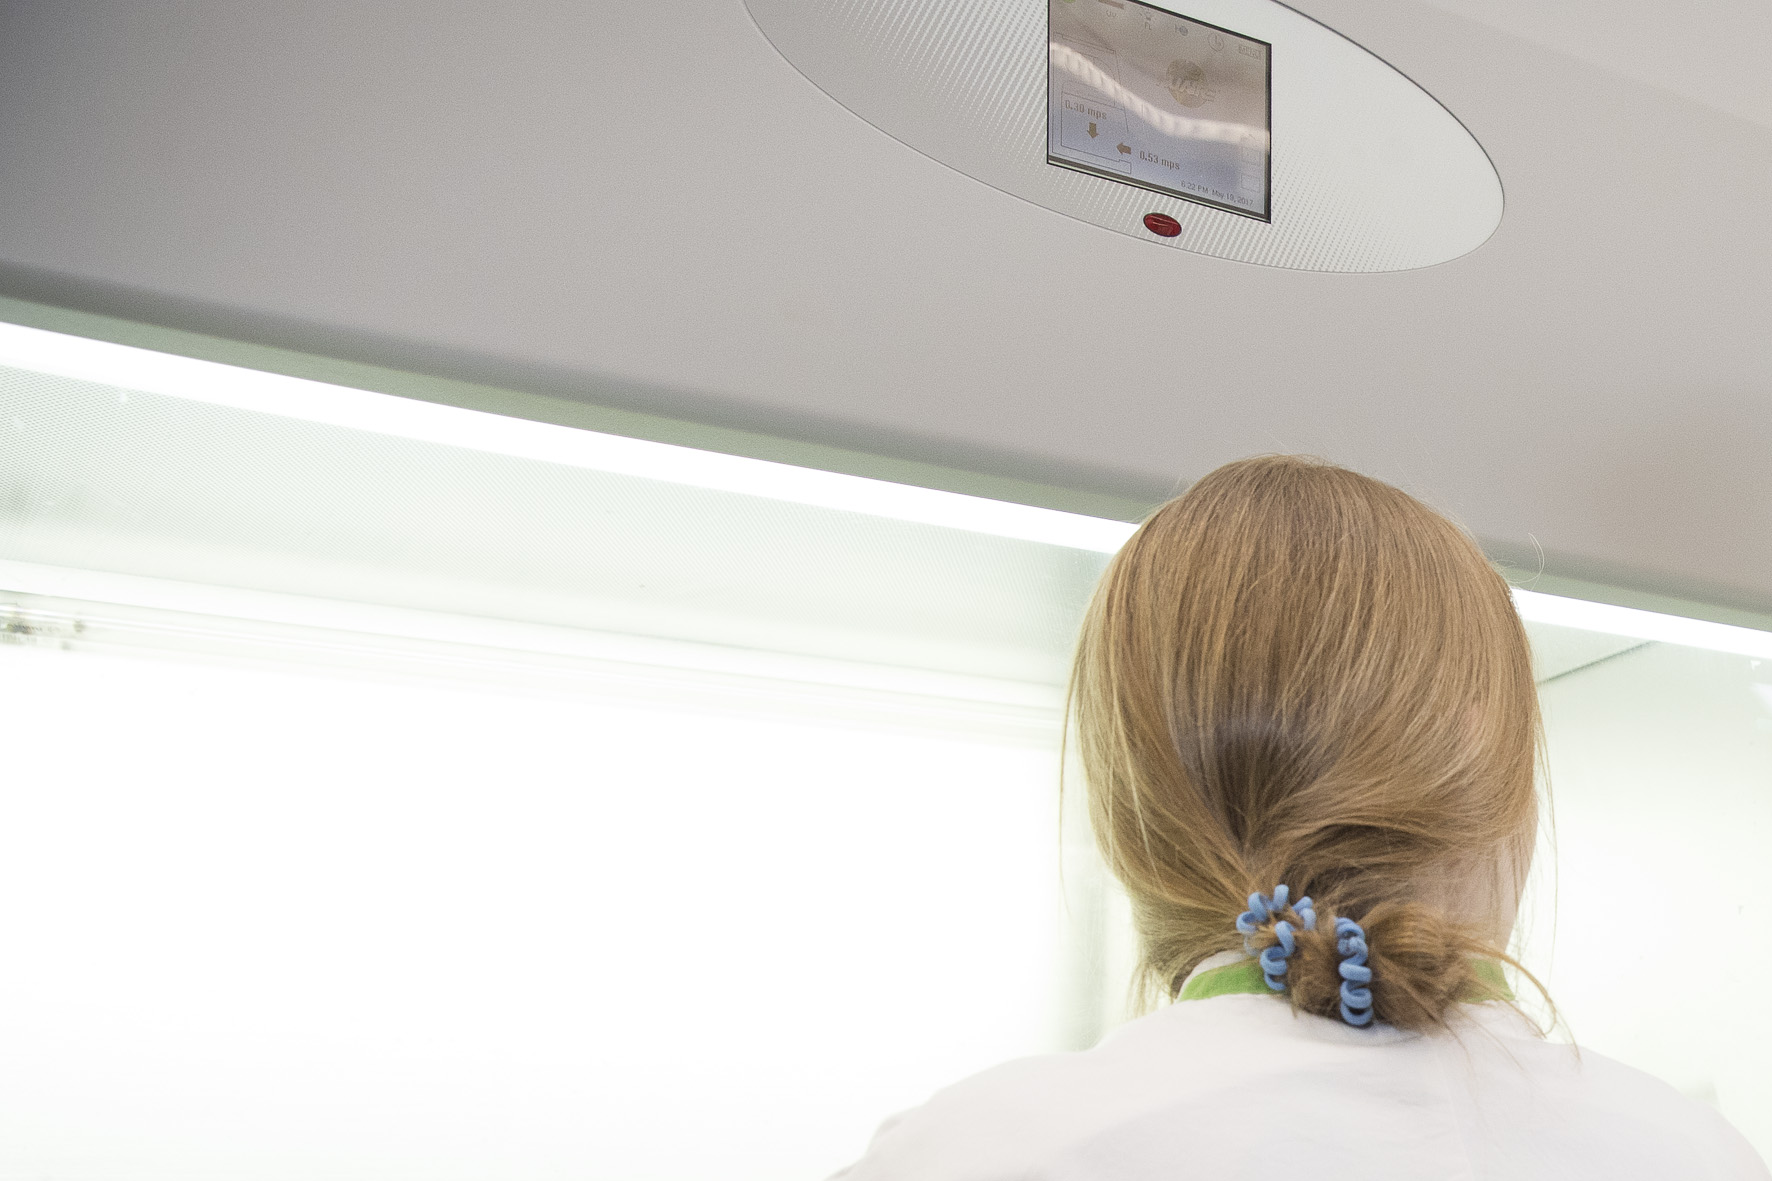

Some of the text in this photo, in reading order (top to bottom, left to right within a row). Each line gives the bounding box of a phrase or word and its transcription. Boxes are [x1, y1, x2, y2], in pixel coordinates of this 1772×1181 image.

[1087, 107, 1108, 120] mps
[1139, 150, 1181, 171] 0.53 mps
[1237, 196, 1254, 206] 2017
